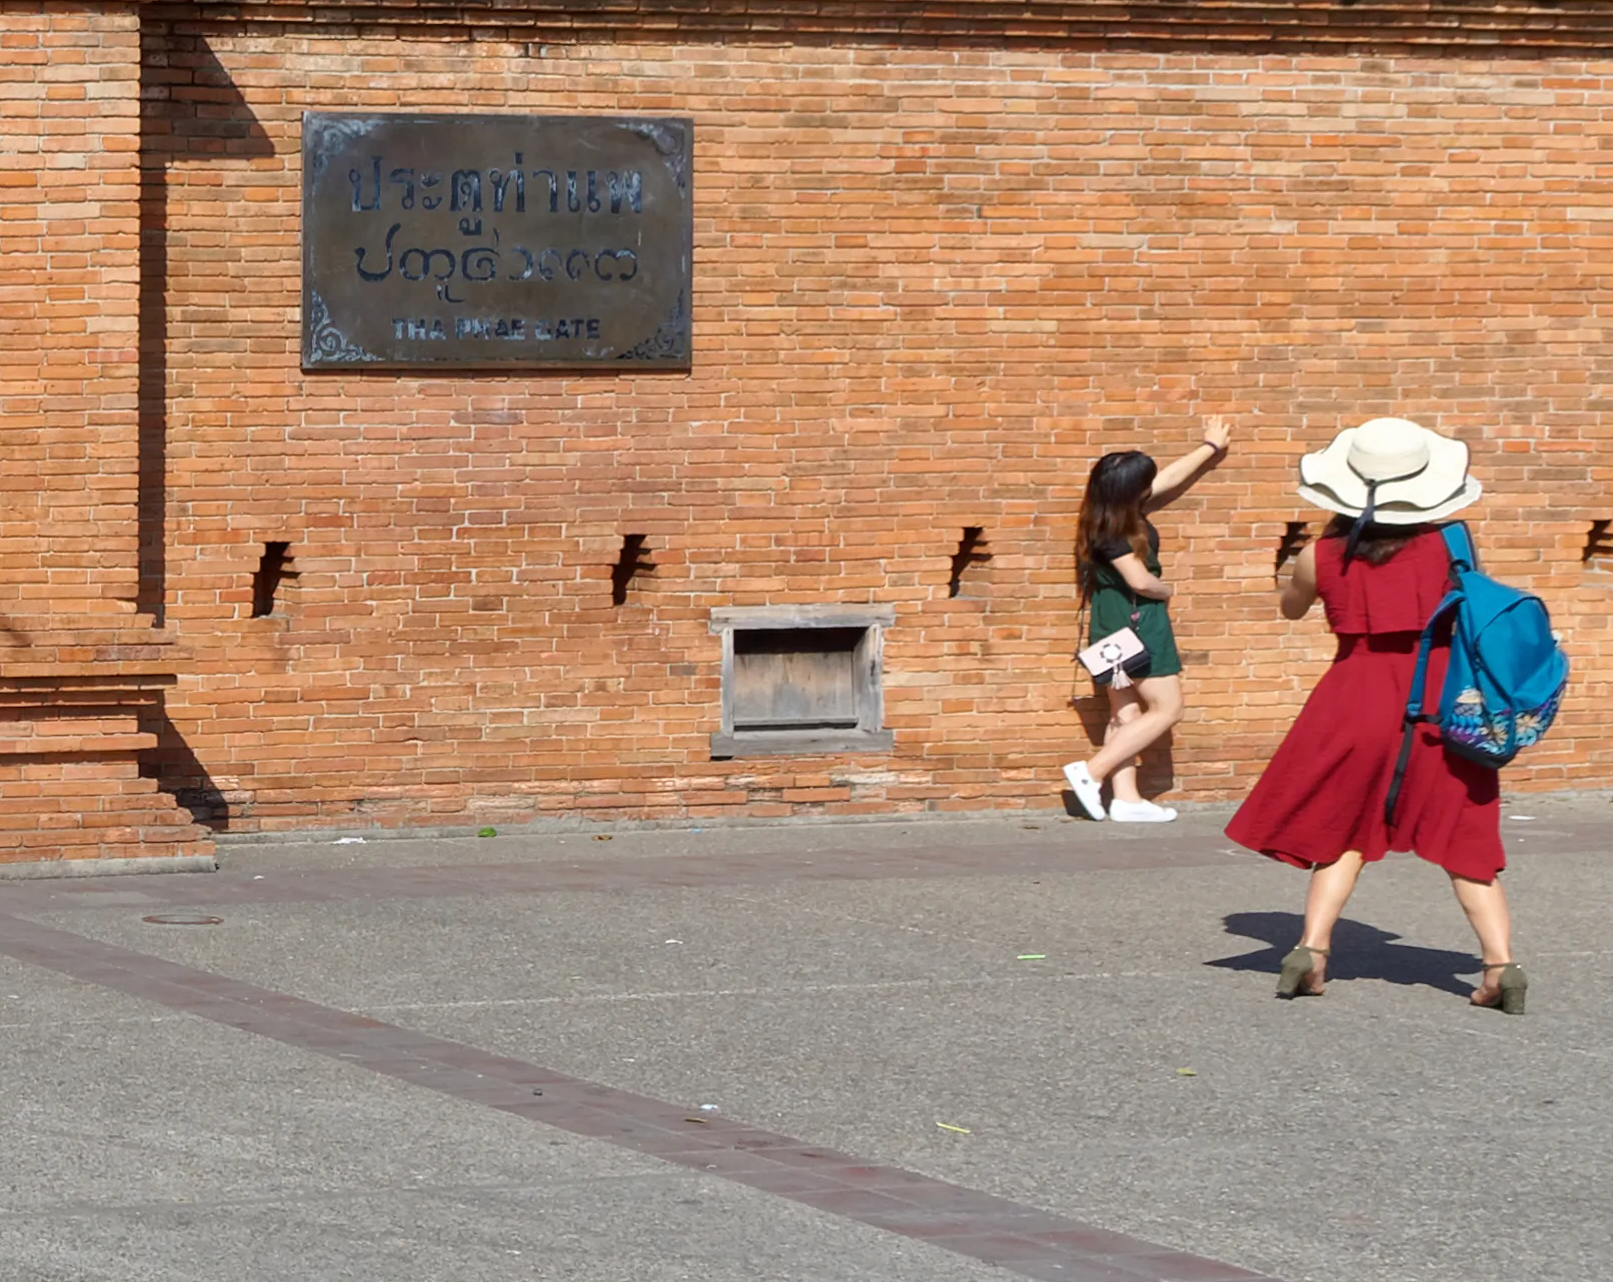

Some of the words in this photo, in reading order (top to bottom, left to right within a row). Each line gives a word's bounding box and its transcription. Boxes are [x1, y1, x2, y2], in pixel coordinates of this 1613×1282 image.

[347, 151, 644, 236] ประตูท่าแพ
[391, 318, 447, 341] THA
[455, 318, 526, 341] PHAE
[534, 318, 601, 340] GATE
